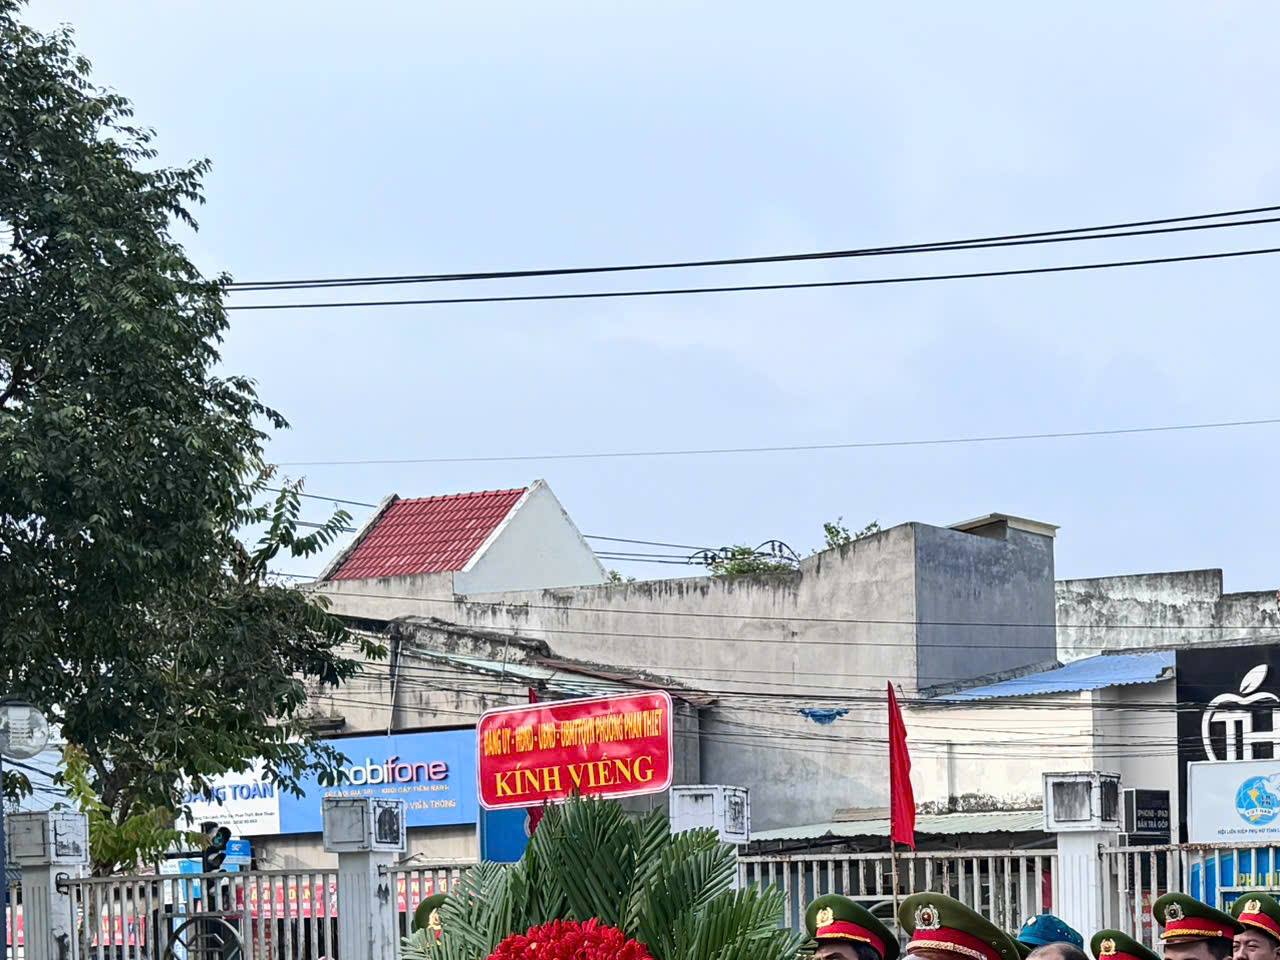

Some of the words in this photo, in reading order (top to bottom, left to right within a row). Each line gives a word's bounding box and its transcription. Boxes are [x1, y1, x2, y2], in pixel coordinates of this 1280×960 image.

[624, 712, 642, 740] PHAN
[495, 763, 563, 797] KÍNH
[567, 752, 654, 788] VIẾNG
[229, 779, 274, 800] TOÀN
